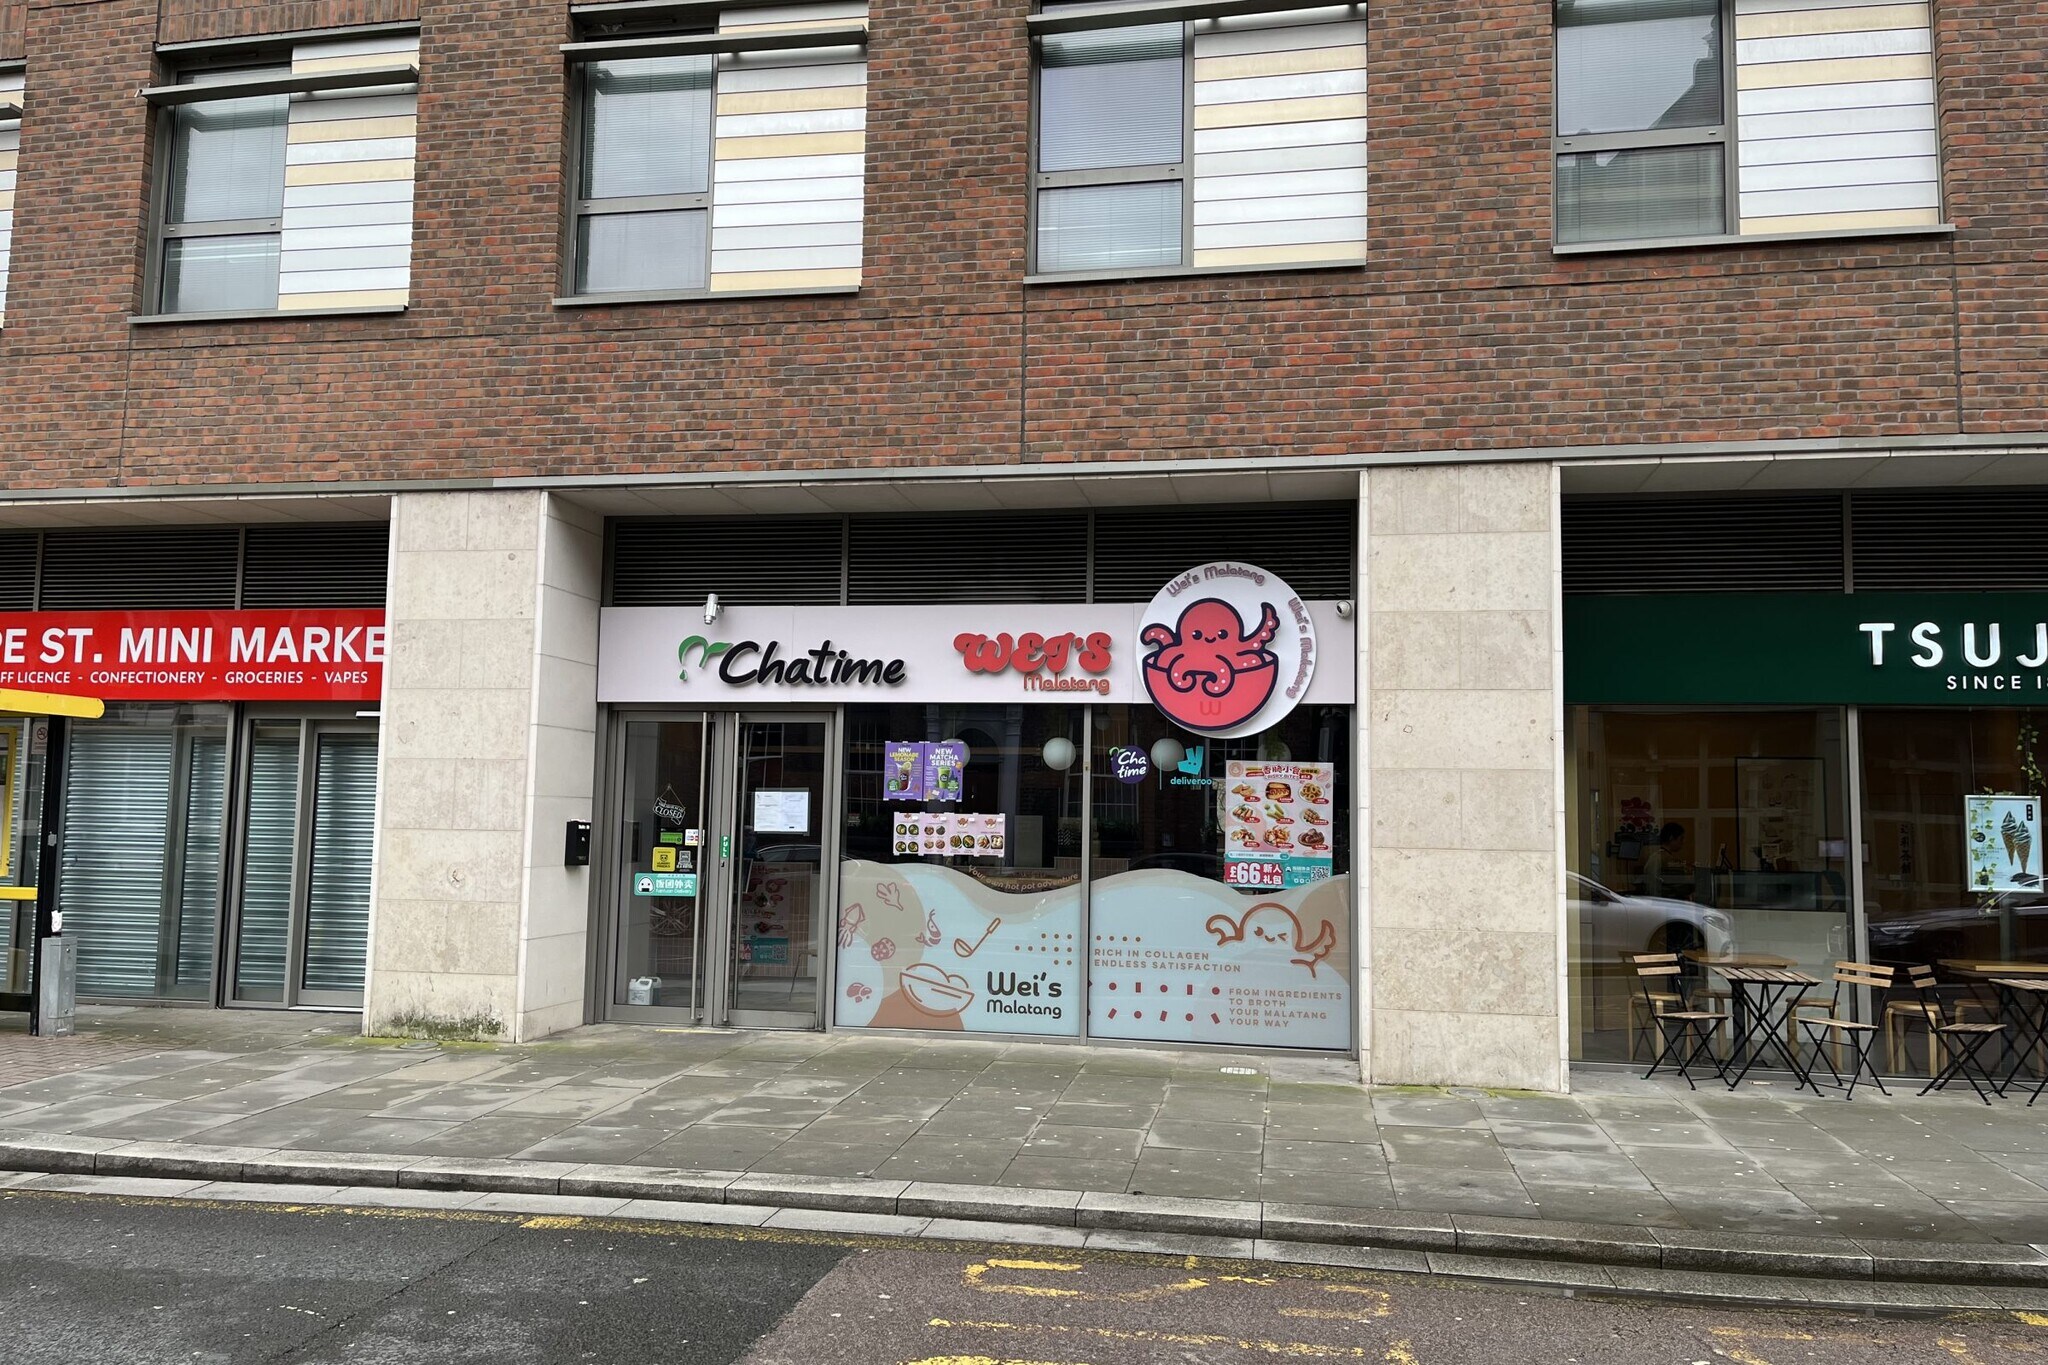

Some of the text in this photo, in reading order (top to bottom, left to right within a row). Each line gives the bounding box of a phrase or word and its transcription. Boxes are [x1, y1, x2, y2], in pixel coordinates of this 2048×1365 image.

[1165, 563, 1266, 597] Wei's Malatang
[0, 628, 27, 664] E
[39, 627, 103, 664] ST.
[119, 626, 213, 664] MINI
[1285, 596, 1313, 698] Wei's Malatang
[1858, 621, 2048, 668] TSUJ
[717, 639, 906, 685] Chatime
[17, 671, 71, 684] LICENCE
[90, 671, 205, 684] CONFECTIONERY
[224, 671, 303, 684] GROCERIES
[324, 671, 368, 684] VAPES
[1023, 672, 1110, 695] Malatang
[1946, 675, 2022, 690] SINCE
[1117, 751, 1147, 765] Cha
[1117, 764, 1147, 779] time
[1170, 776, 1213, 785] deliveroo
[655, 805, 682, 819] CLOSED
[1094, 948, 1210, 961] RICH IN COLLAGEN
[1094, 959, 1242, 973] ENDLESS SATISFACTION
[986, 970, 1063, 998] Wei's
[1229, 988, 1342, 1001] FROM INGREDIENTS
[986, 999, 1062, 1019] Malatang
[1229, 998, 1287, 1008] TO BROTH
[1229, 1008, 1327, 1020] YOUR MALATANG
[1229, 1018, 1290, 1028] YOUR WAY
